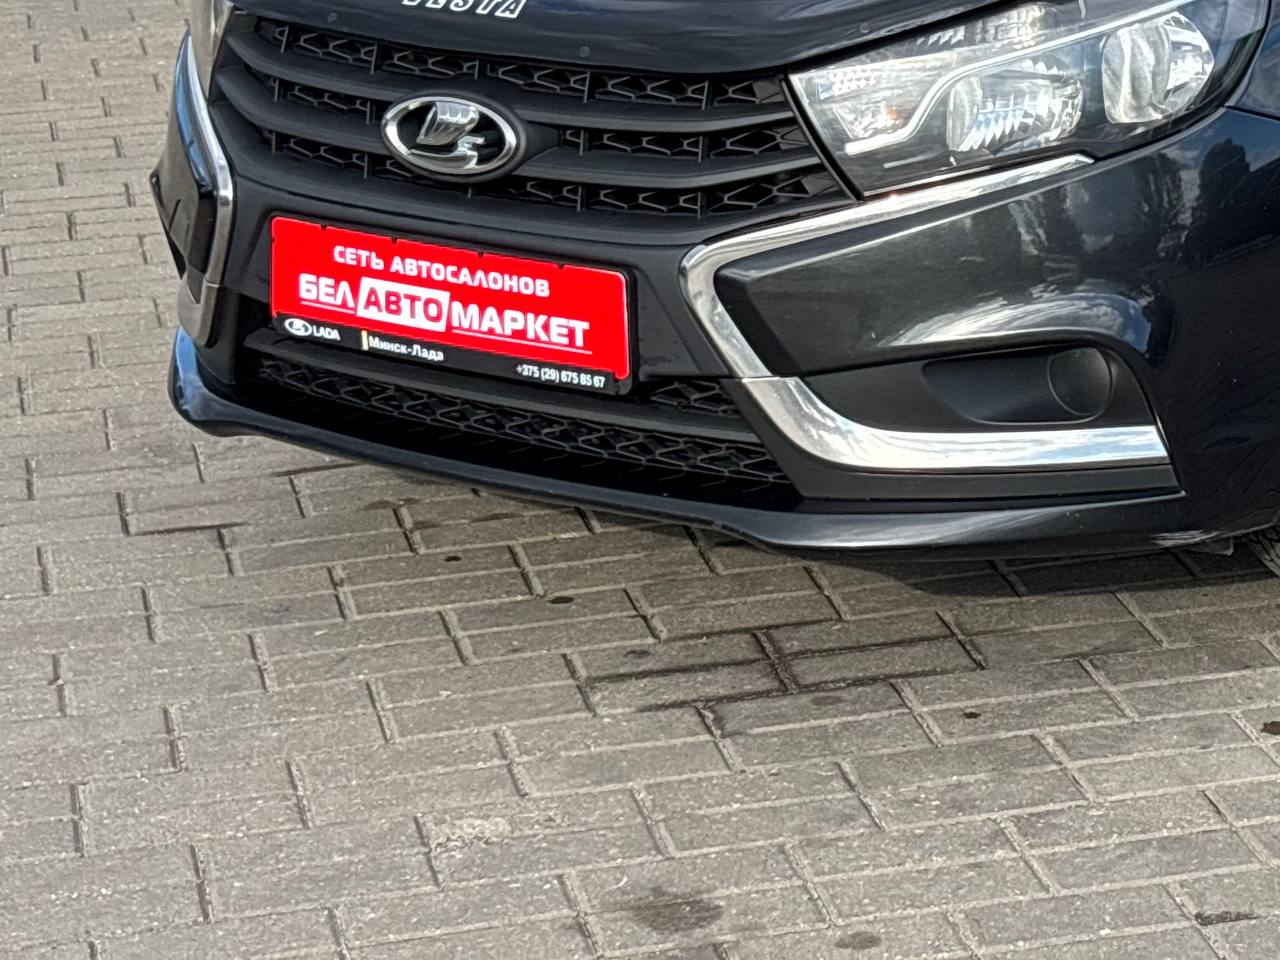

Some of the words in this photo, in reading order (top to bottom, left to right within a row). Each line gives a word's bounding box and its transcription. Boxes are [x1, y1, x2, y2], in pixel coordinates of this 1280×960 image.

[333, 245, 385, 270] СЕТЬ
[390, 256, 550, 297] АВТОСАЛОНОВ
[312, 325, 342, 342] LADA
[369, 336, 445, 362] Минск-Лада
[516, 364, 539, 378] +375
[541, 367, 560, 383] (29)
[561, 370, 578, 384] 675
[593, 375, 605, 388] 67
